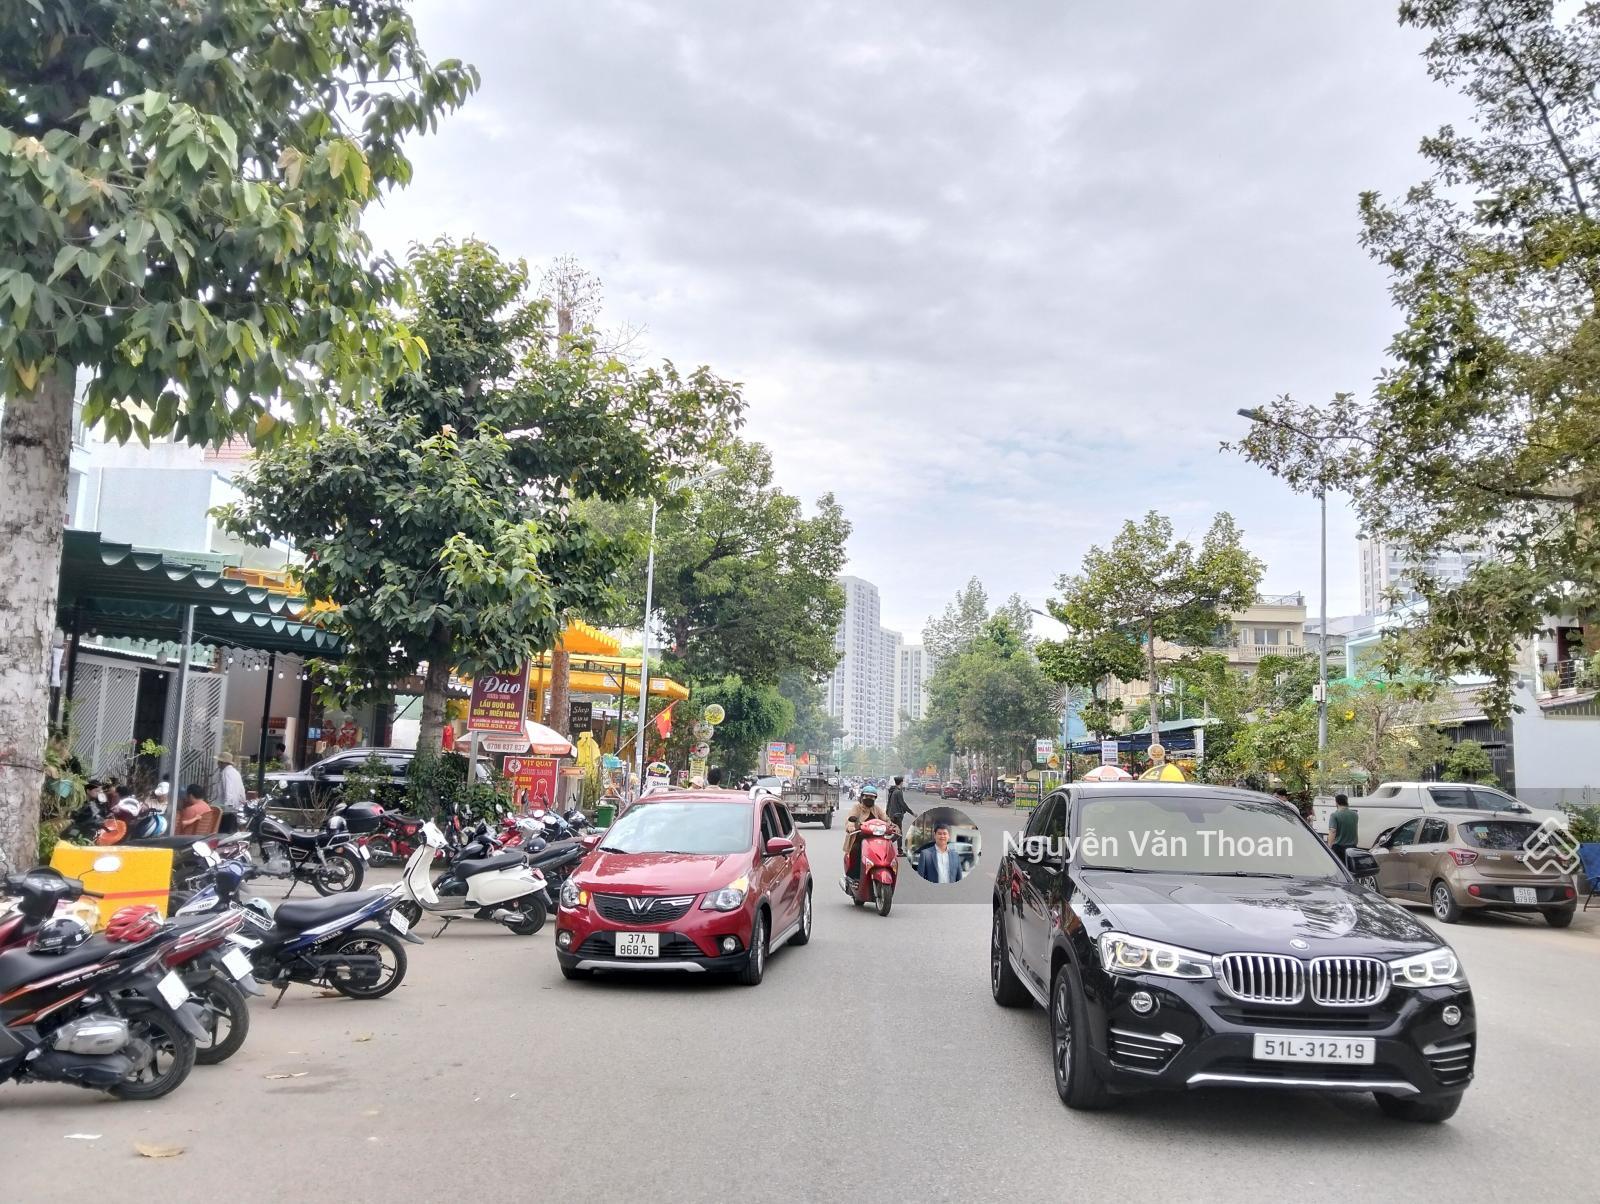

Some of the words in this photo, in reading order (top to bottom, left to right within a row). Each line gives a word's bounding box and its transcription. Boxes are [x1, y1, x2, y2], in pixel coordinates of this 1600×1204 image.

[479, 676, 521, 694] Đào
[628, 934, 647, 944] 37A
[620, 944, 654, 955] 868.76
[1264, 1040, 1365, 1059] 51L-312.19
